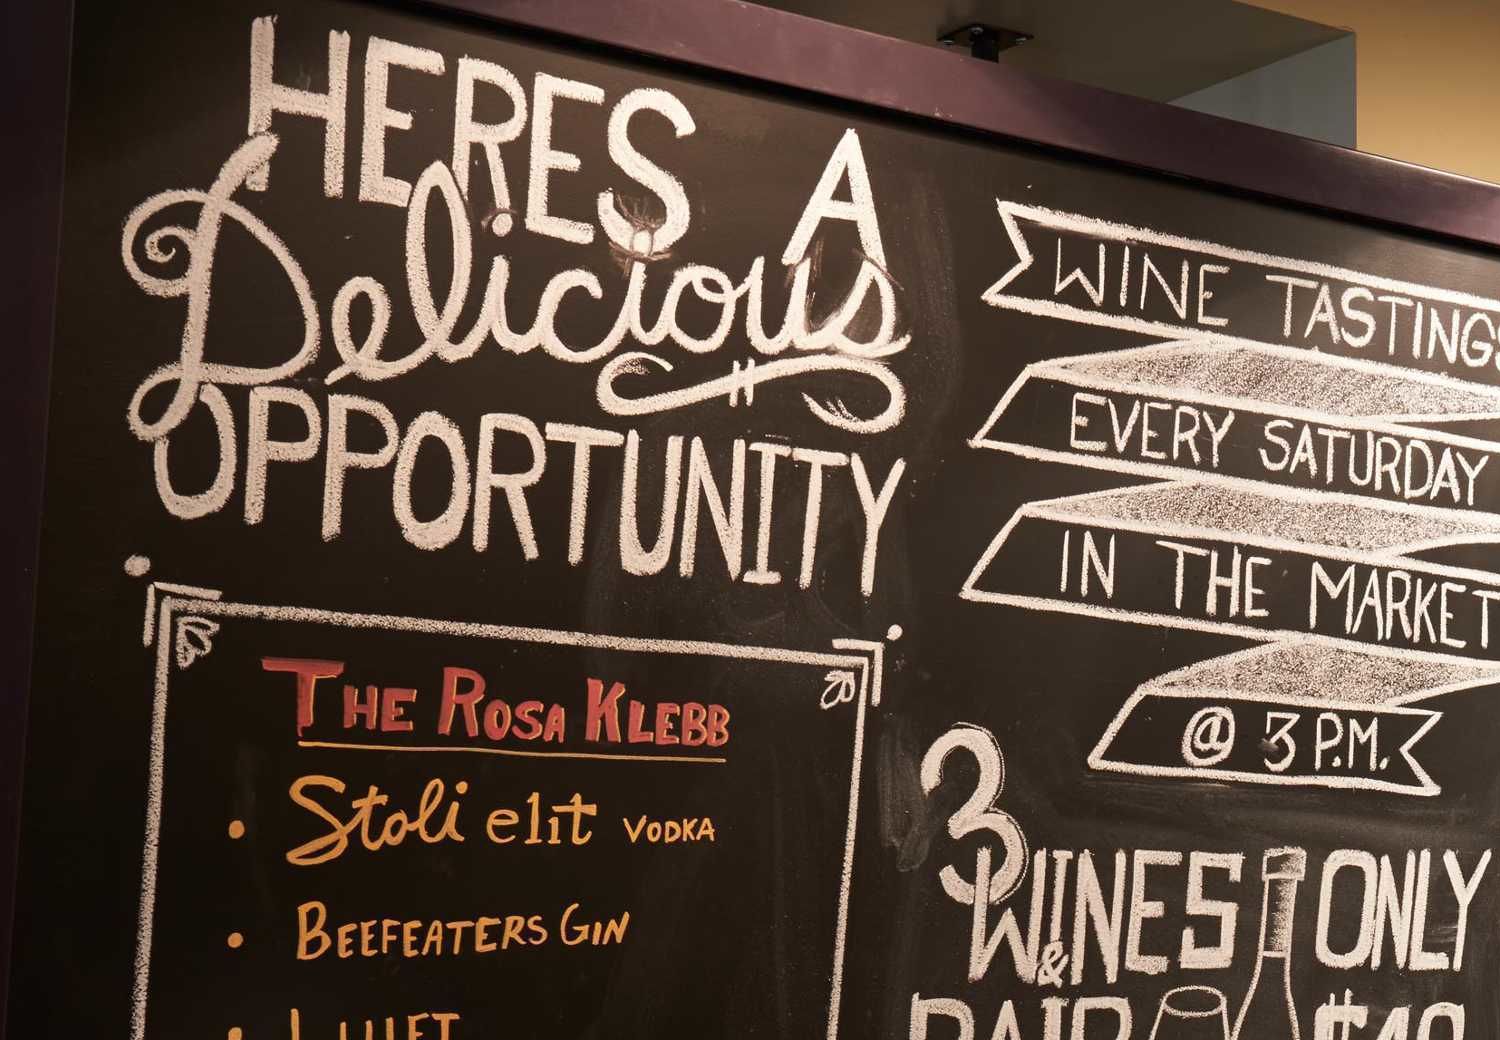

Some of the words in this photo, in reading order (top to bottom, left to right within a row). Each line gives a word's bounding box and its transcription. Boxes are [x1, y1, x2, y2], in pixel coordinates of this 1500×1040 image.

[250, 16, 694, 255] HERES
[782, 128, 892, 275] A
[121, 132, 913, 442] Delicious
[1056, 237, 1231, 329] WINE
[153, 382, 907, 598] OPPORTUNITY
[1069, 392, 1235, 468] EVERY
[1259, 418, 1490, 506] SATURDAY
[1060, 529, 1116, 600] IN
[1157, 539, 1273, 619] THE
[1181, 705, 1236, 768] @
[1263, 711, 1297, 775] 3
[1314, 712, 1390, 773] P.M.
[285, 774, 470, 867] Stoli
[623, 815, 717, 844] VODKA
[920, 721, 1029, 906] 3
[295, 900, 549, 961] BEEFEATERS
[967, 847, 1245, 986] WINES
[1037, 940, 1071, 988] &
[1315, 847, 1493, 972] ONLY
